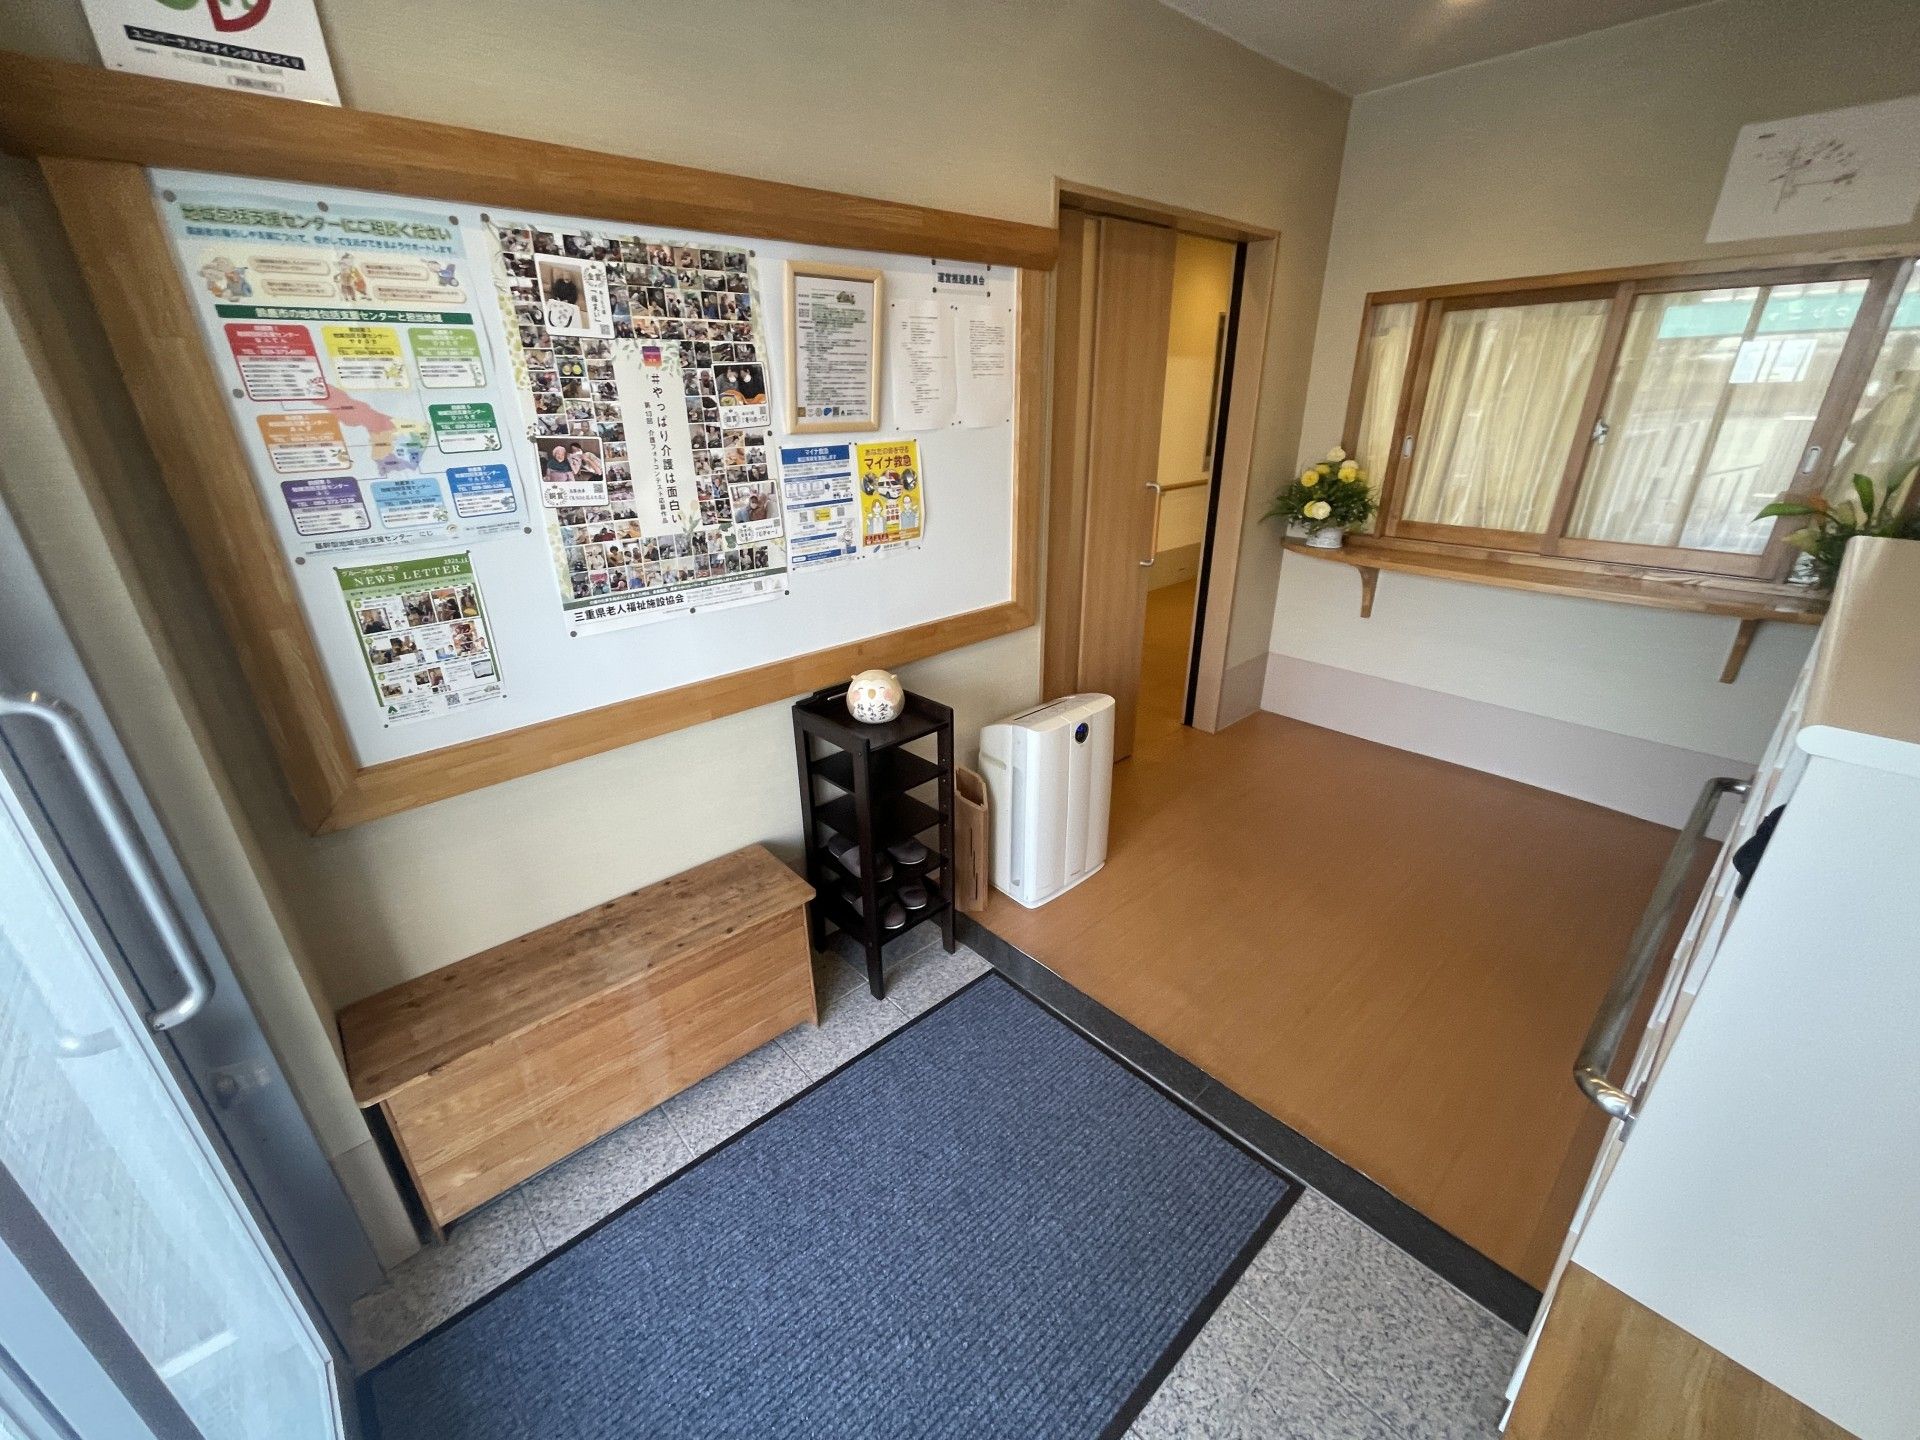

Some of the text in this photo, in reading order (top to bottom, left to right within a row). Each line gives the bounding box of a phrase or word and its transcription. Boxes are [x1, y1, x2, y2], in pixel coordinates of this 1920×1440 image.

[864, 455, 912, 471] マイナ救急
[354, 572, 396, 586] NEWS
[402, 563, 461, 580] LETTER
[574, 594, 685, 622] 三重県老人福祉施設協会
